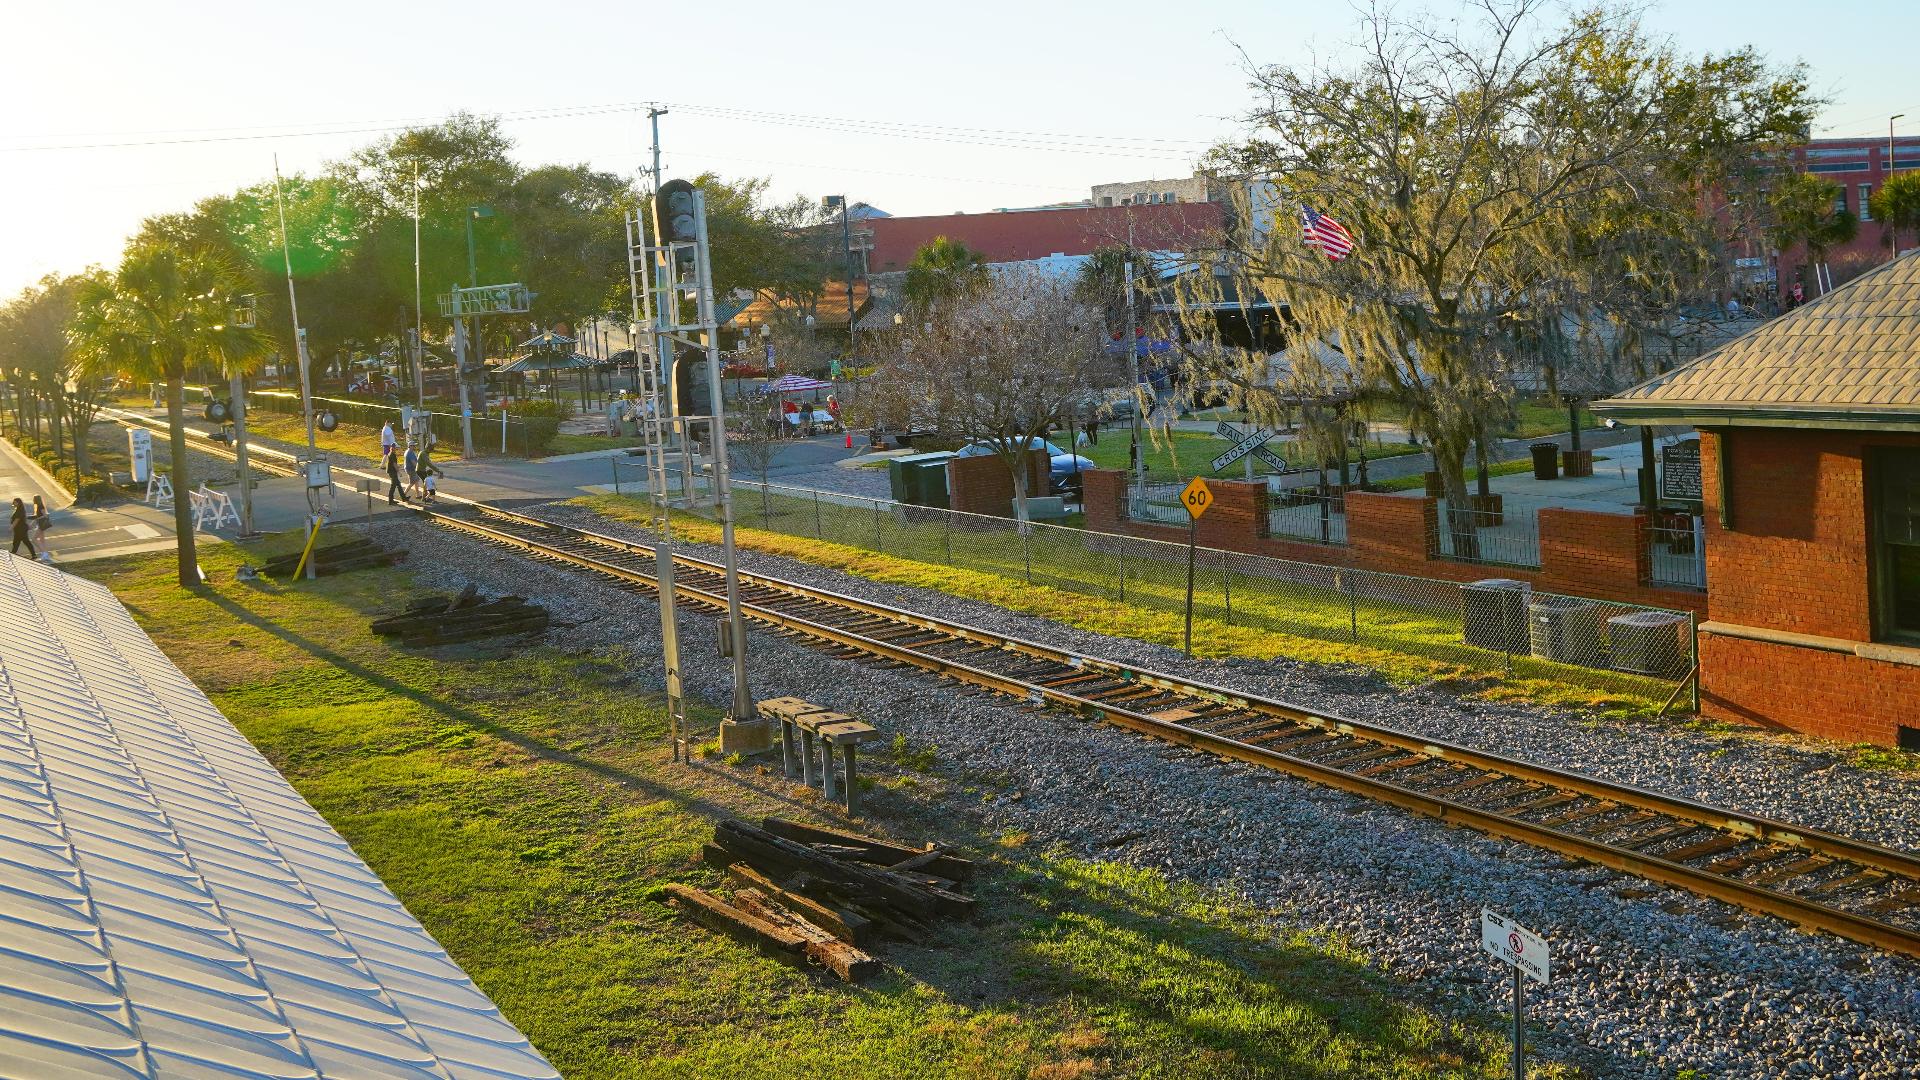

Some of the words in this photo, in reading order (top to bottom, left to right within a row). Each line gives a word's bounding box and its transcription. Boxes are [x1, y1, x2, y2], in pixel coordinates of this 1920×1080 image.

[1217, 429, 1270, 467] CROSSING
[1220, 423, 1240, 441] RAIL
[1260, 451, 1284, 469] ROAD
[1188, 490, 1206, 506] 60
[1487, 914, 1504, 928] CSX
[1490, 941, 1498, 951] NO
[1503, 947, 1541, 976] TRESPASSING
